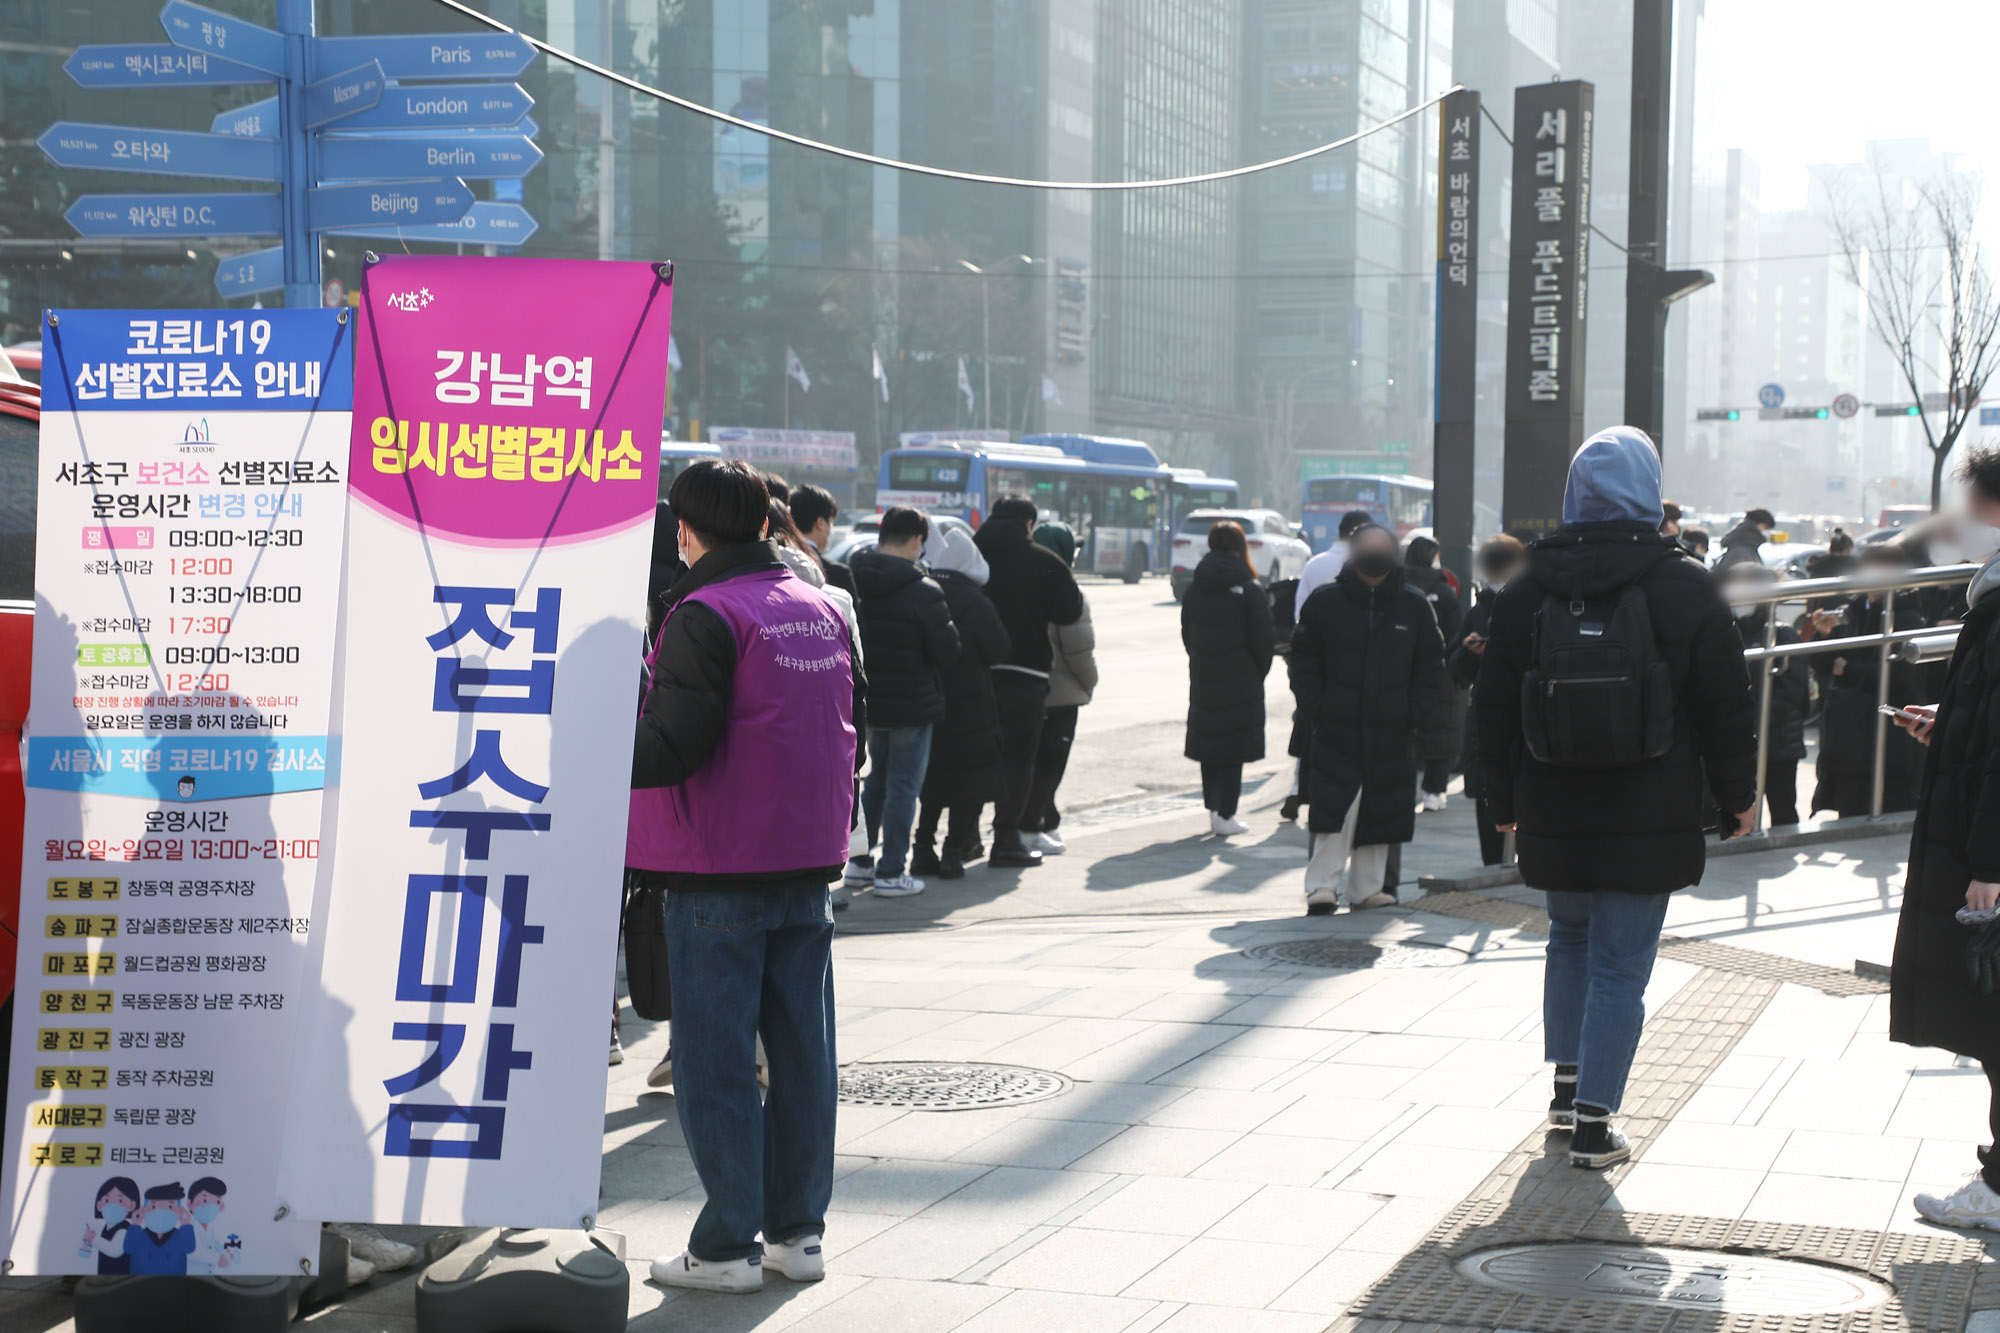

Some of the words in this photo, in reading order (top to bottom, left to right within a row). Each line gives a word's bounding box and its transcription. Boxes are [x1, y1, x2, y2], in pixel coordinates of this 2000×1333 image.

[202, 21, 226, 49] 평양
[431, 46, 471, 63] Paris
[125, 54, 207, 76] 멕시코시티
[333, 84, 360, 104] Moscow
[407, 97, 468, 115] London
[85, 140, 98, 150] km
[1450, 116, 1471, 160] 서초
[111, 140, 171, 163] 오타와
[427, 148, 475, 165] Berlin
[1535, 108, 1567, 223] 서리풀
[371, 194, 418, 214] Beijing
[129, 206, 177, 227] 워싱턴
[183, 206, 216, 225] D.C.
[388, 292, 420, 311] 서초
[1529, 239, 1563, 401] 푸드트럭존
[126, 319, 271, 356] 코로나19
[75, 361, 243, 400] 선별진료소
[254, 361, 321, 399] 안내
[434, 350, 593, 410] 강남역
[370, 416, 643, 483] 임시선별검사소
[55, 461, 129, 486] 서초구
[136, 461, 210, 485] 보건소
[218, 460, 340, 486] 선별진료소
[91, 494, 191, 518] 운영시간
[199, 493, 246, 518] 변경
[254, 493, 303, 518] 안내
[169, 529, 303, 547] 09:00~12:30
[169, 558, 233, 576] 12:00
[169, 586, 302, 604] 13:30~18:00
[169, 617, 231, 635] 17:30
[81, 647, 97, 663] 토
[101, 646, 148, 664] 공휴일
[165, 646, 300, 664] 09:00~13:00
[166, 674, 229, 691] 12:30
[73, 696, 94, 708] 현장
[97, 696, 119, 708] 진행
[122, 696, 155, 708] 상황에
[157, 696, 179, 708] 따라
[182, 696, 225, 708] 조기마감
[242, 696, 253, 708] 수
[256, 696, 299, 708] 있습니다
[86, 715, 145, 730] 일요일은
[148, 715, 193, 730] 운영을
[197, 715, 226, 730] 하지
[230, 714, 289, 730] 않습니다
[49, 749, 112, 772] 서울시
[119, 749, 162, 772] 직영
[168, 749, 258, 772] 코로나19
[265, 749, 326, 772] 검사소
[144, 811, 229, 833] 운영시간
[44, 839, 184, 861] 월요일~일요일
[190, 839, 320, 860] 13:00~21:00
[382, 585, 562, 1160] 접수마감
[127, 879, 173, 897] 창동역
[178, 879, 255, 897] 공영주차장
[125, 918, 234, 935] 잠실종합운동장
[237, 917, 310, 935] 제2주차장
[123, 955, 201, 973] 월드컵공원
[205, 955, 267, 973] 평화광장
[121, 993, 199, 1011] 목동운동장
[203, 993, 233, 1011] 남문
[238, 993, 284, 1010] 주차장
[118, 1031, 150, 1049] 광진
[154, 1031, 186, 1049] 광장
[116, 1070, 148, 1087] 동작
[151, 1069, 215, 1087] 주차공원
[37, 1108, 103, 1127] 서대문구
[113, 1108, 161, 1125] 독립문
[164, 1108, 197, 1125] 광장
[110, 1147, 157, 1164] 테크노
[161, 1146, 225, 1164] 근린공원
